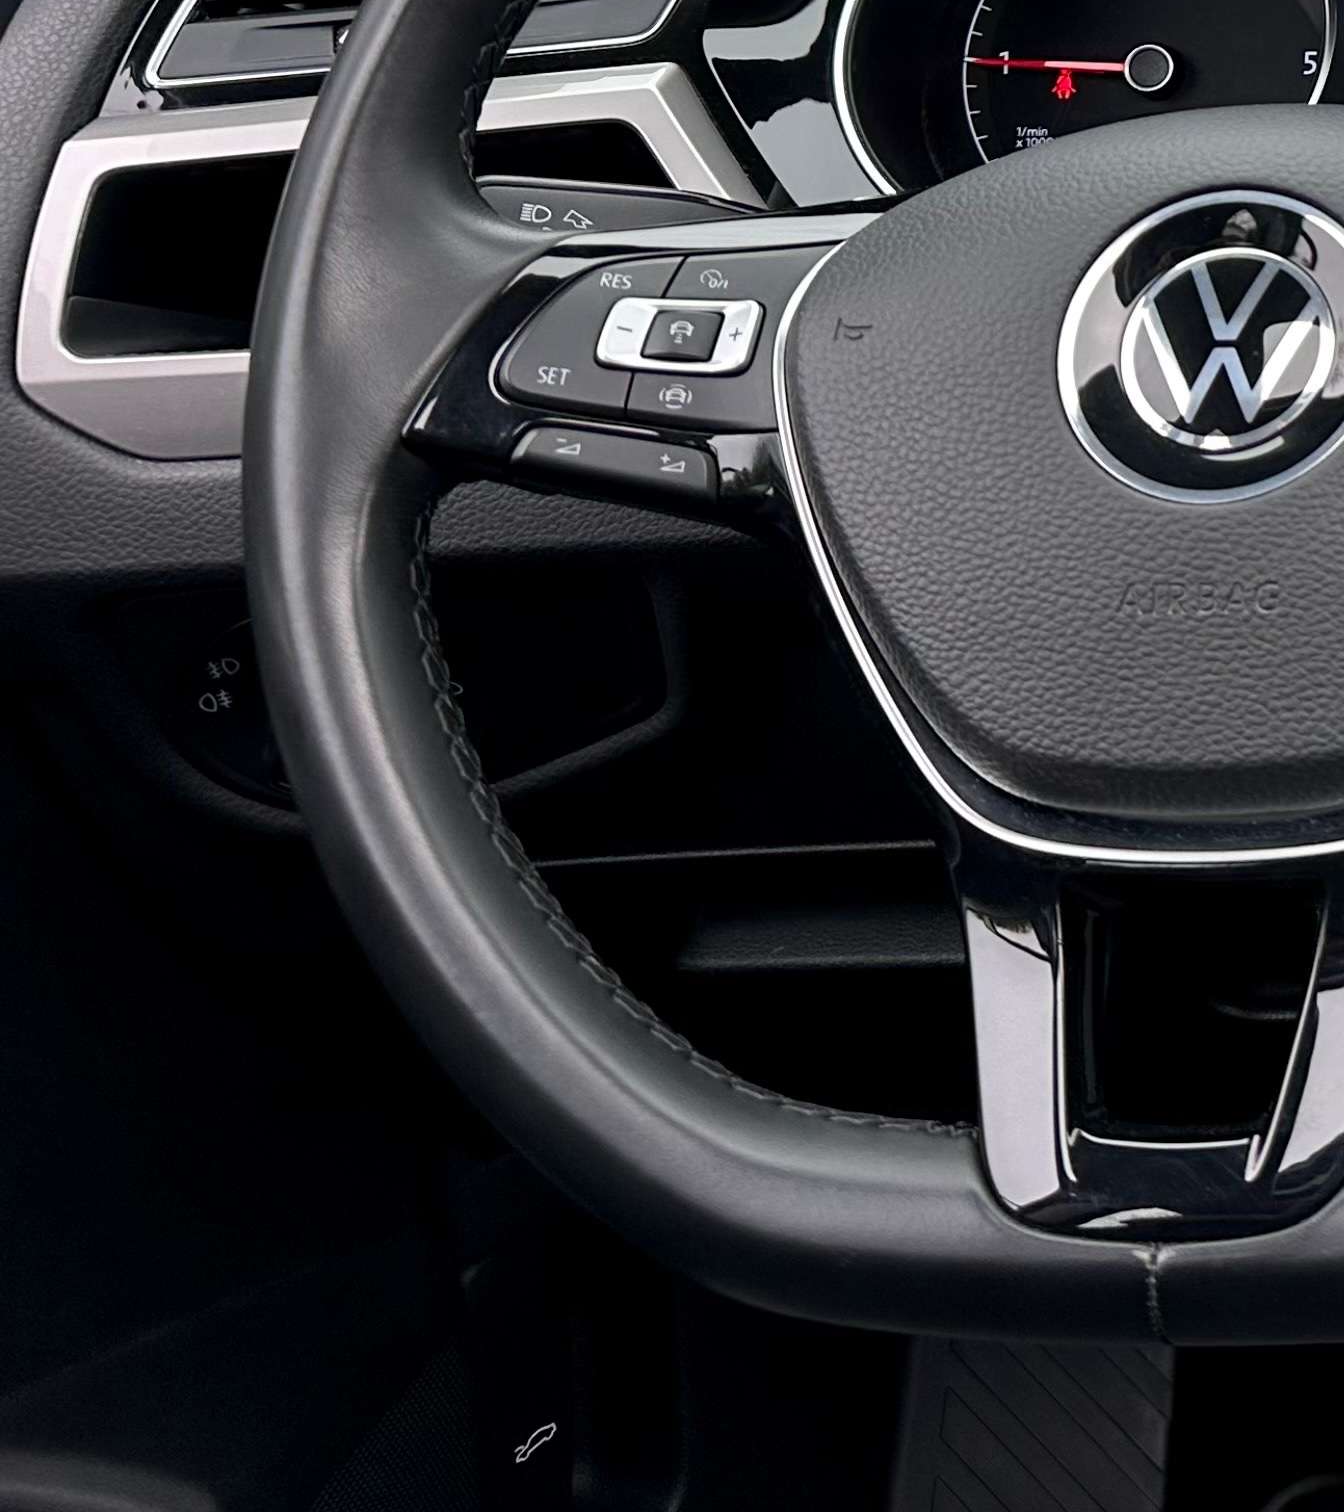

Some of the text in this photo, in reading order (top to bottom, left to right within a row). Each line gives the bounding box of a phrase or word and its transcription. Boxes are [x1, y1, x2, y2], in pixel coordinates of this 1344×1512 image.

[1304, 51, 1317, 74] 5
[1016, 126, 1048, 138] 1/min
[1016, 139, 1023, 148] x
[600, 273, 632, 289] RES
[538, 367, 570, 385] SET
